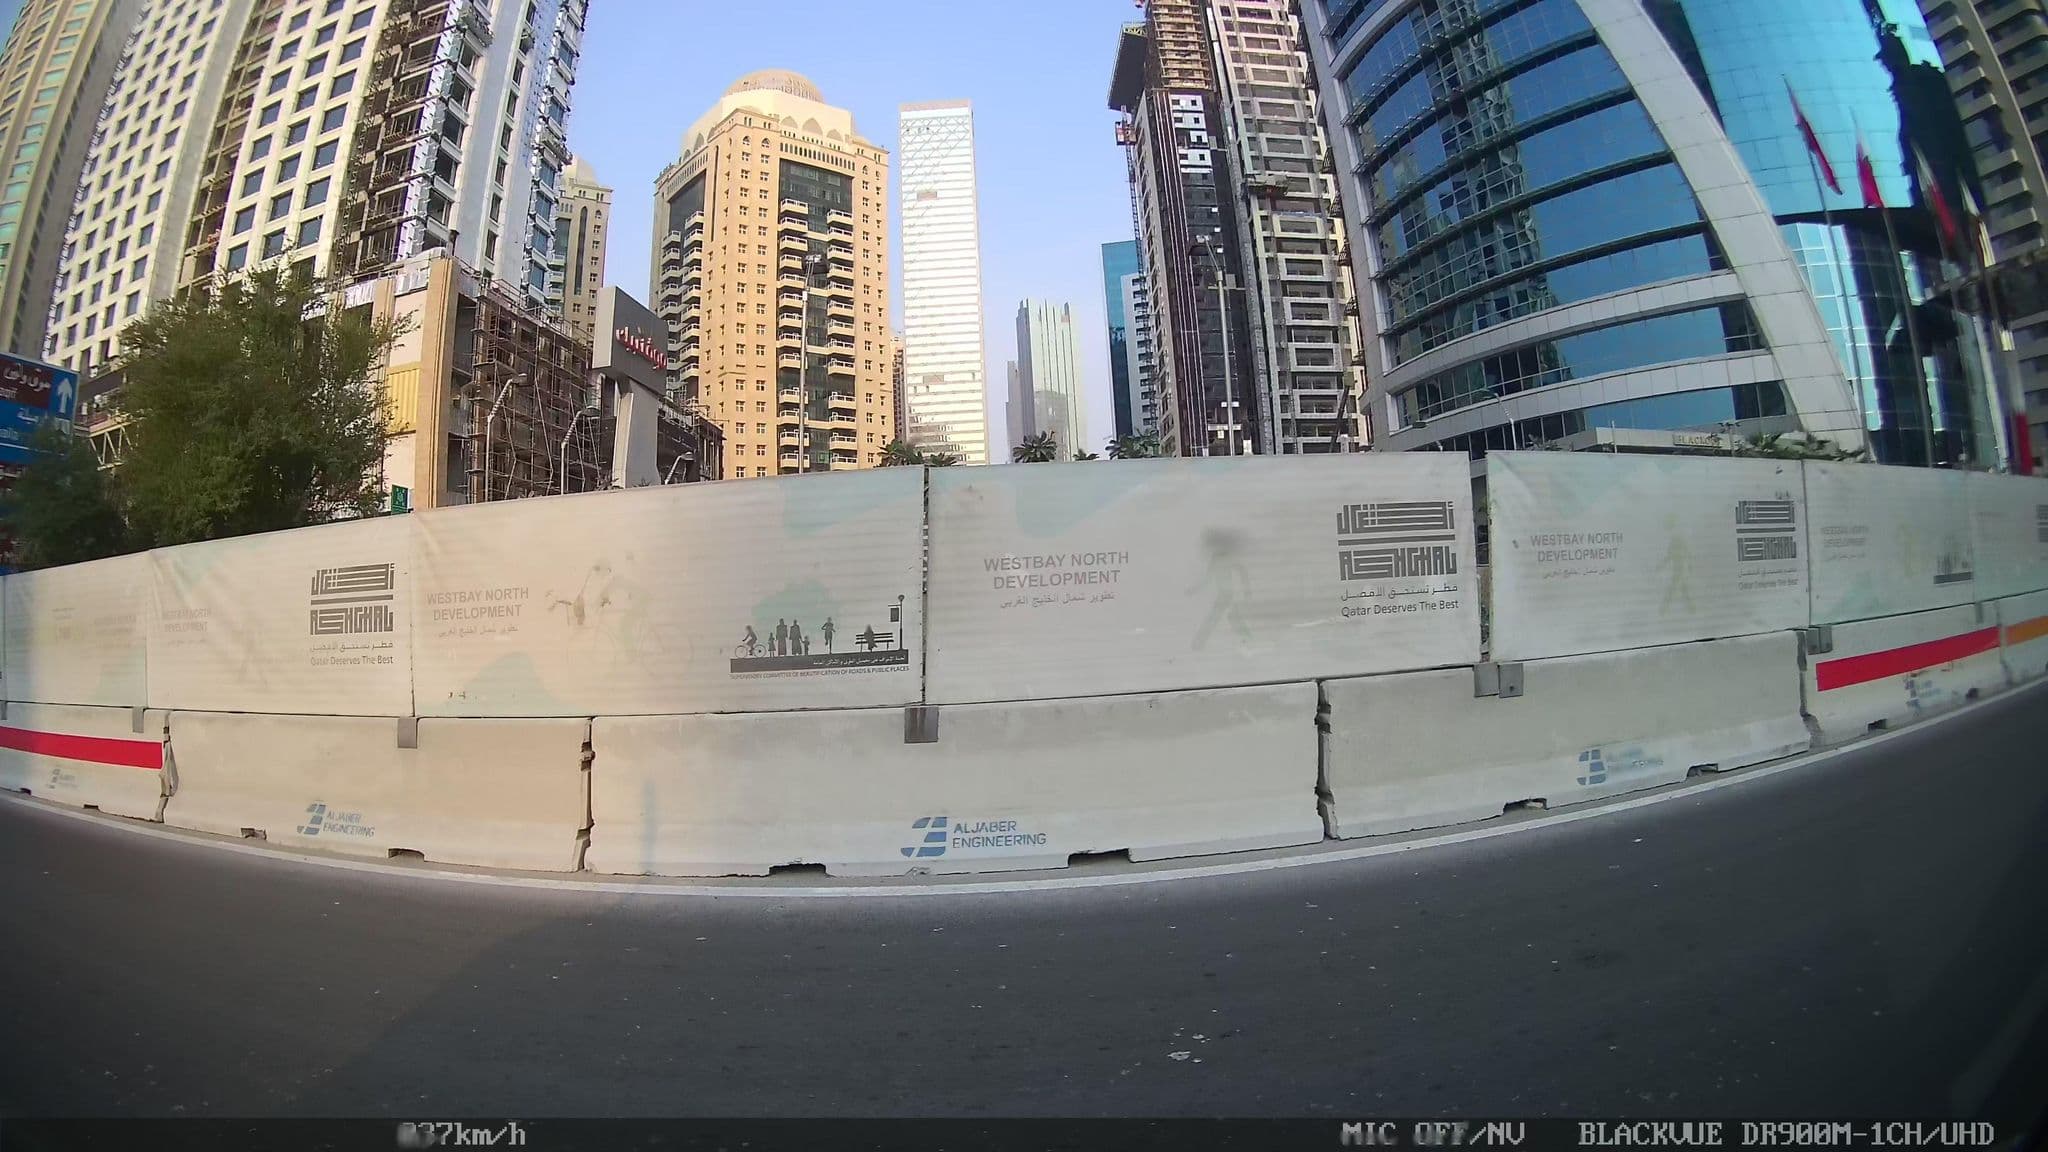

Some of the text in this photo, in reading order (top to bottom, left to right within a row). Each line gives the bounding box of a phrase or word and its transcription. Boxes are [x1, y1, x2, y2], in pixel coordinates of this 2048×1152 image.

[1529, 531, 1624, 547] WESTBAY NORTH
[983, 551, 1129, 571] WESTBAY NORTH
[1536, 547, 1618, 562] DEVELOPMENT
[1338, 545, 1458, 582] ASHGHAL
[993, 569, 1121, 589] DEVELOPMENT
[426, 587, 529, 606] WESTBAY NORTH
[1431, 582, 1458, 595] قطر
[433, 604, 522, 621] DEVELOPMENT
[1341, 599, 1459, 618] Qatar Deserves The Best
[310, 605, 395, 636] ASHGHAL
[362, 655, 377, 665] The
[377, 655, 394, 664] Best
[953, 820, 1017, 833] ALJABER
[952, 833, 1047, 848] ENGINEERING
